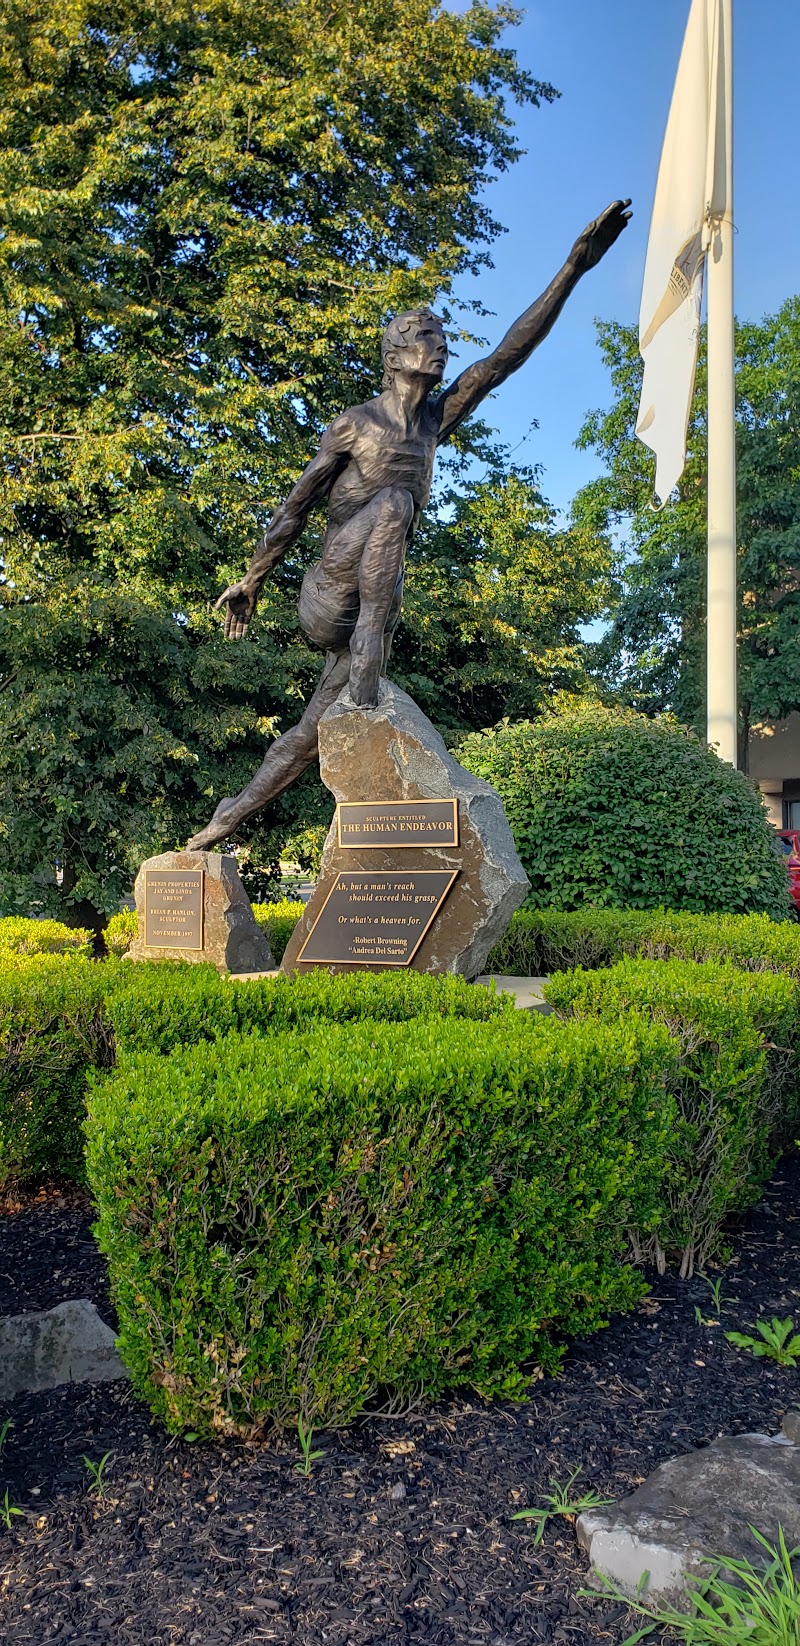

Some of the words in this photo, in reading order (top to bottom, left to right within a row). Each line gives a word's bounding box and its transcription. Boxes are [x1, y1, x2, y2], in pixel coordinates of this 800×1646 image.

[342, 824, 360, 832] THE
[363, 823, 398, 832] HUMAN
[400, 822, 452, 831] ENDEAVOR
[394, 882, 415, 890] reach
[381, 916, 406, 924] heaven
[408, 916, 420, 926] for.
[378, 938, 408, 946] Browning
